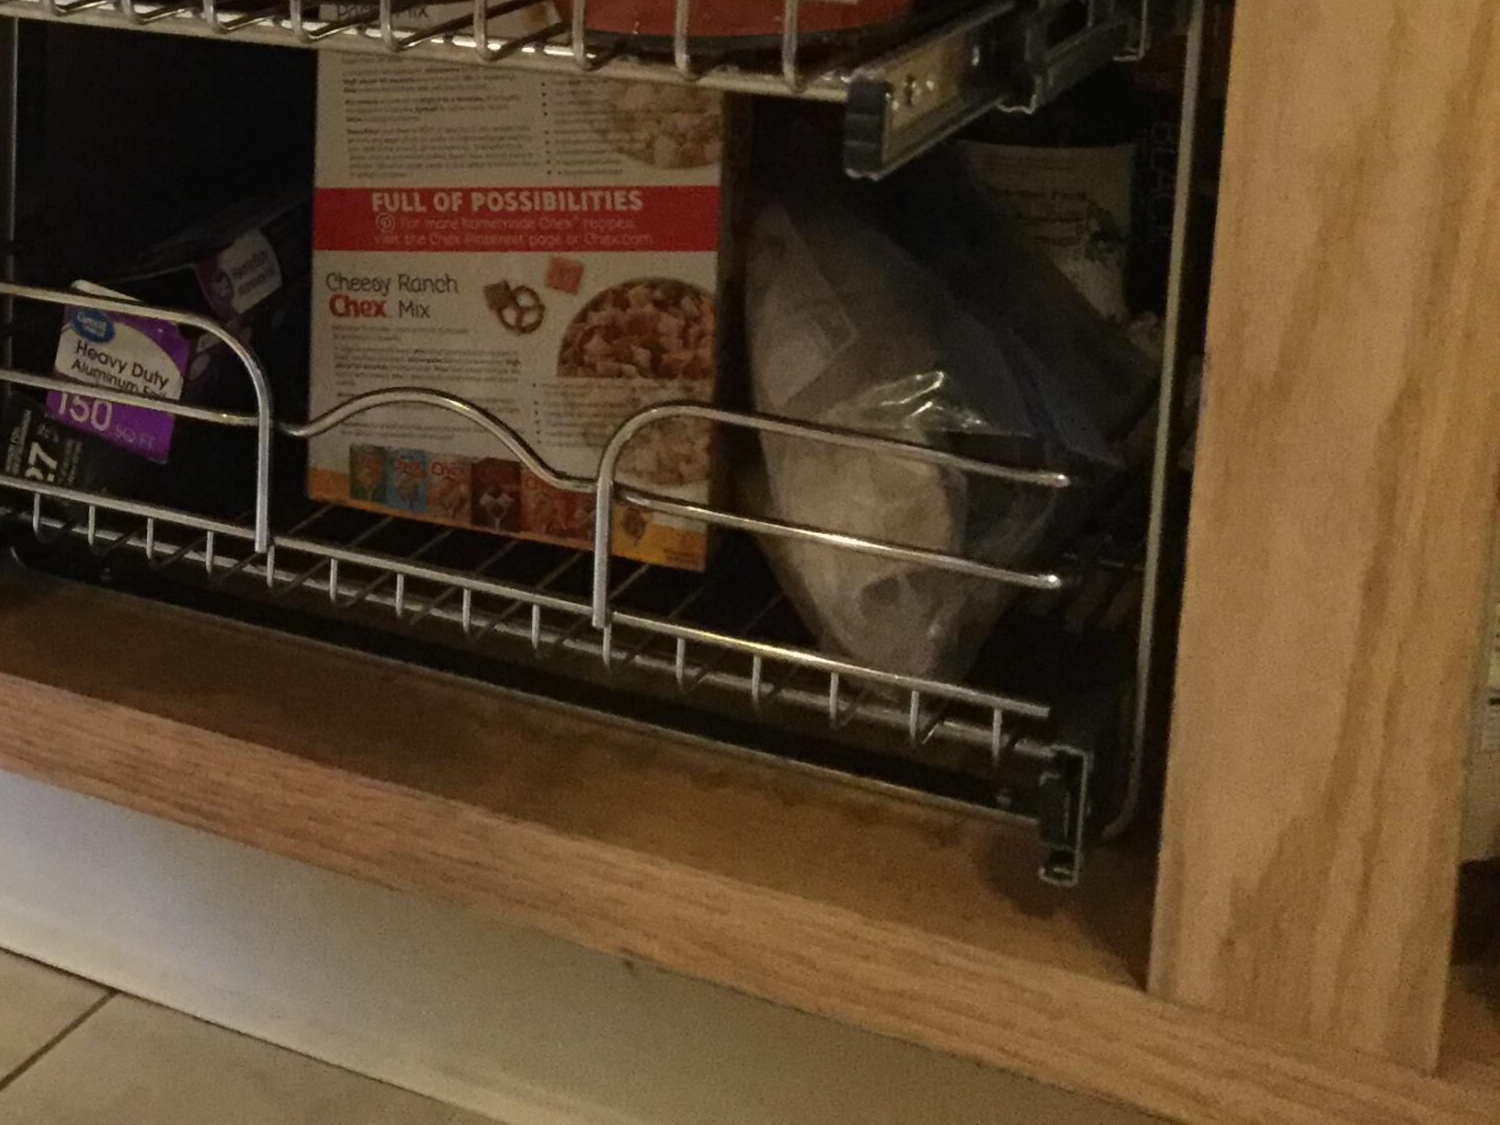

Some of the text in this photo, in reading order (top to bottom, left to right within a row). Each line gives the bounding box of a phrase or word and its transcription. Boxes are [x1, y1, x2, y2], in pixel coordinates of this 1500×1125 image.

[371, 190, 643, 213] FULL OF POSSIBILITIES
[462, 217, 535, 230] homemade
[405, 233, 426, 246] the
[429, 233, 461, 246] Chex
[529, 235, 563, 248] page
[325, 273, 460, 297] Cheesy Ranch
[329, 294, 431, 319] Chex Mix
[71, 358, 140, 394] Aluminum
[75, 339, 170, 391] Heavy Duty
[58, 392, 113, 432] 150
